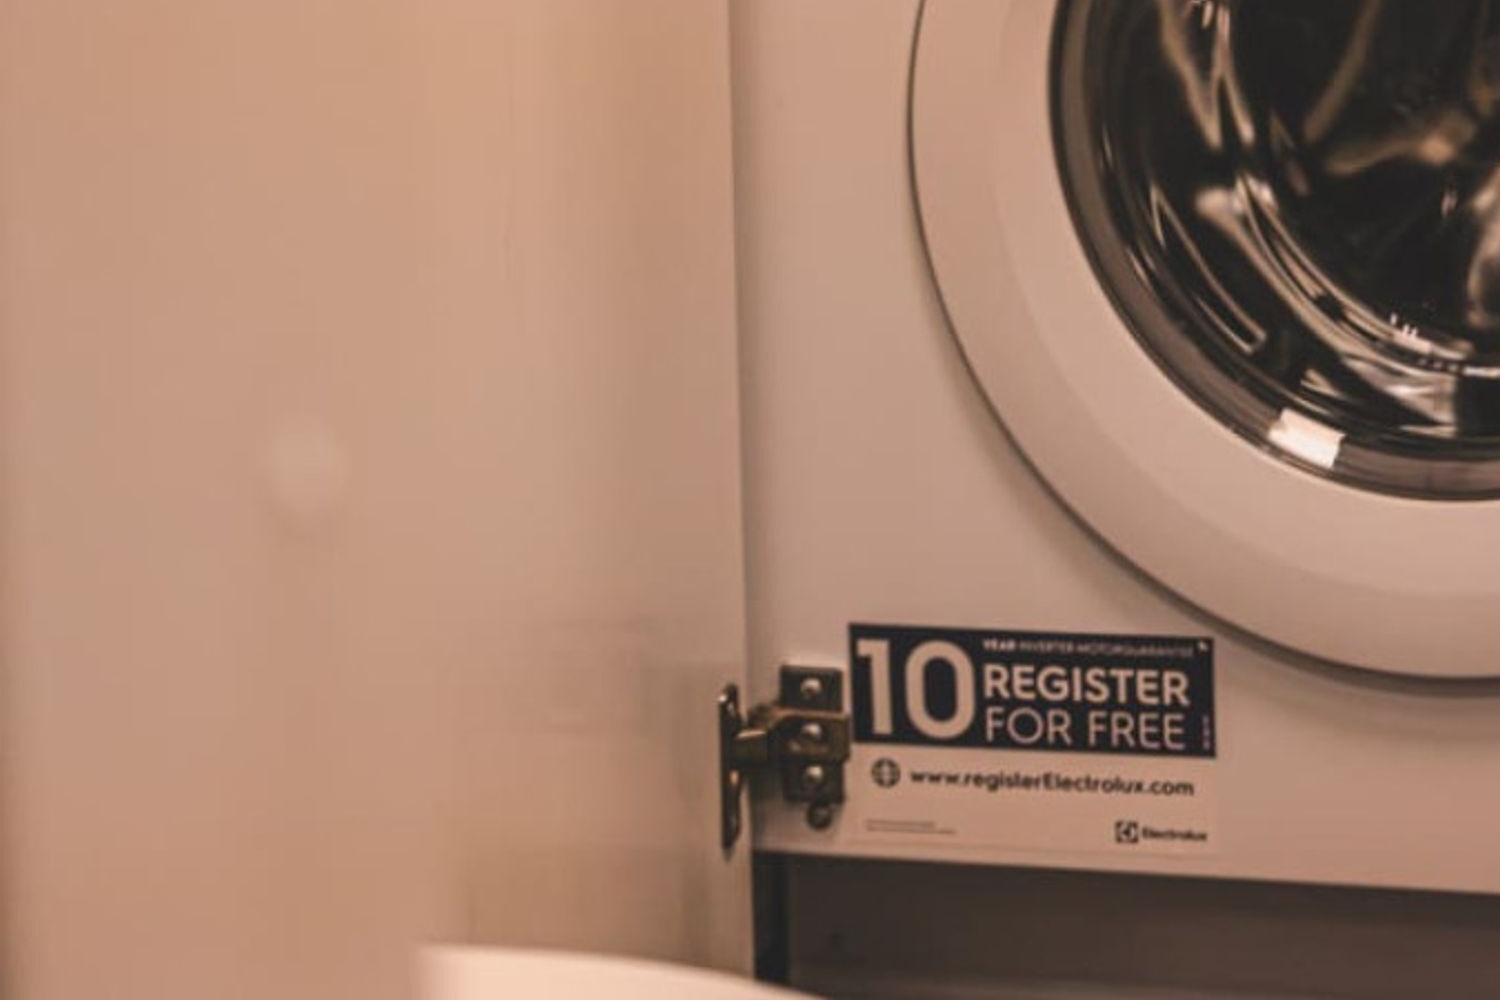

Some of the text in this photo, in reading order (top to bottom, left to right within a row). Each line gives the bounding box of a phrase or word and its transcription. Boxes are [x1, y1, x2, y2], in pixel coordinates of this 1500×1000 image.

[855, 638, 976, 740] 10
[982, 664, 1191, 706] REGISTER
[985, 706, 1073, 745] FOR
[1088, 711, 1186, 751] FREE
[909, 767, 1195, 797] www.registerElectrolux.com
[1141, 826, 1208, 843] Electrolux
